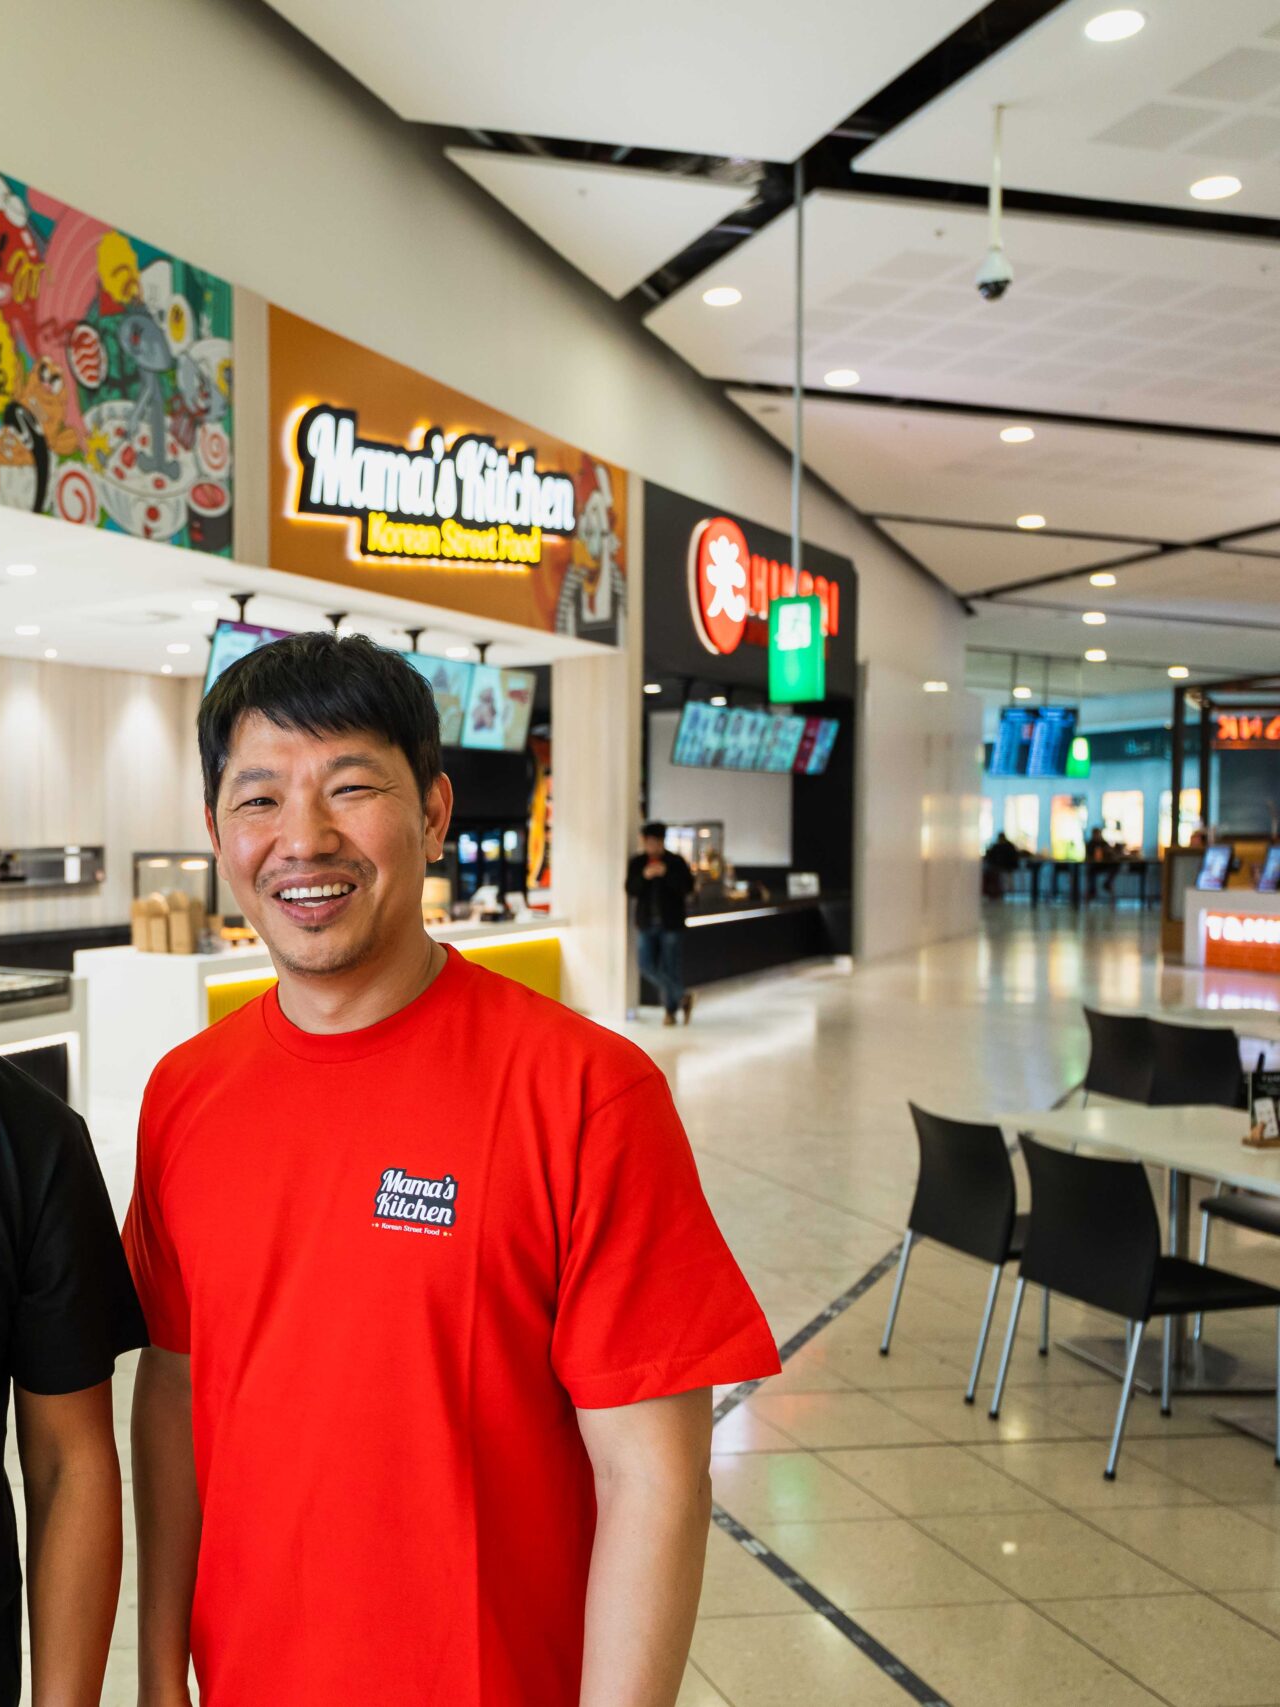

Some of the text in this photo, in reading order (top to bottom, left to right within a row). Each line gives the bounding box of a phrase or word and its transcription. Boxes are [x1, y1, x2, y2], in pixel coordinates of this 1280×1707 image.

[306, 412, 576, 532] Mama's Kitchen
[498, 524, 542, 563] Food
[380, 1169, 456, 1200] Mama's
[376, 1192, 452, 1225] Kitchen
[381, 1222, 441, 1236] Korean Street Food
